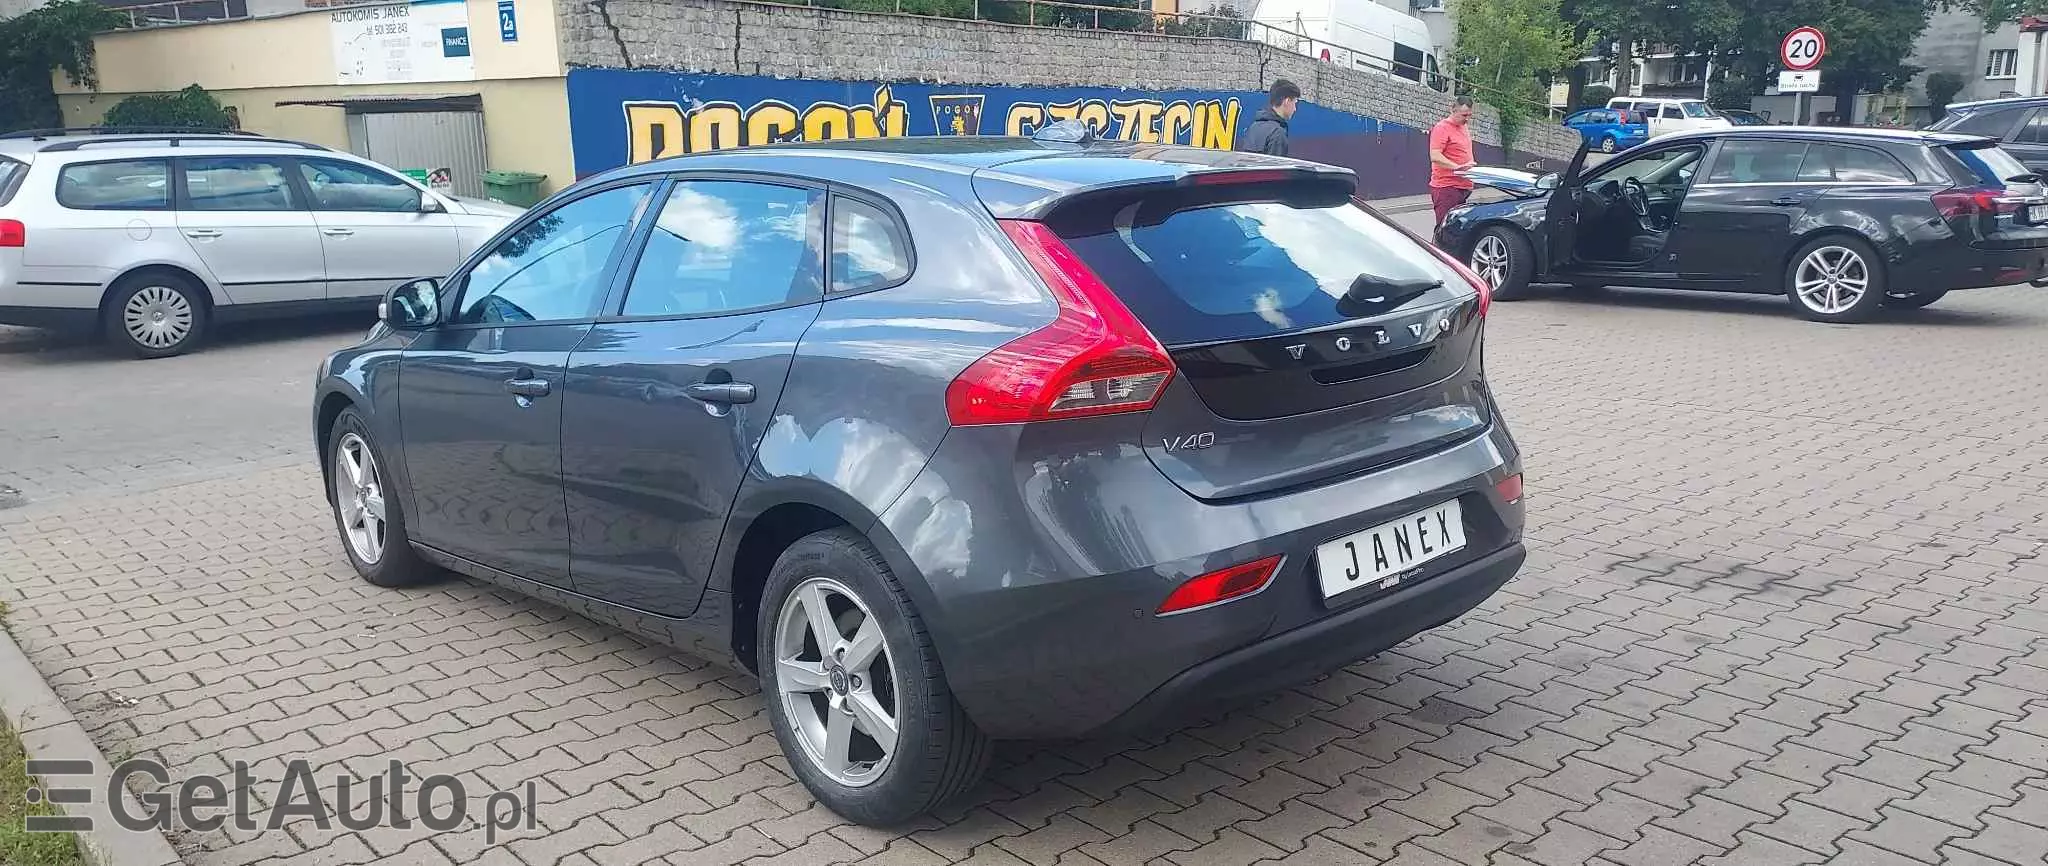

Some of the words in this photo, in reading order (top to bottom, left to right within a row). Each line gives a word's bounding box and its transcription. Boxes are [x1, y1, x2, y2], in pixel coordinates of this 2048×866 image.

[331, 8, 380, 23] AUTOKOMIS
[382, 5, 411, 19] JANEX
[502, 12, 514, 31] 2a
[445, 37, 468, 46] FINANCE
[1789, 38, 1818, 59] 20
[1285, 317, 1451, 361] VOLVO
[1162, 432, 1216, 454] V40
[1344, 509, 1451, 581] JANEX
